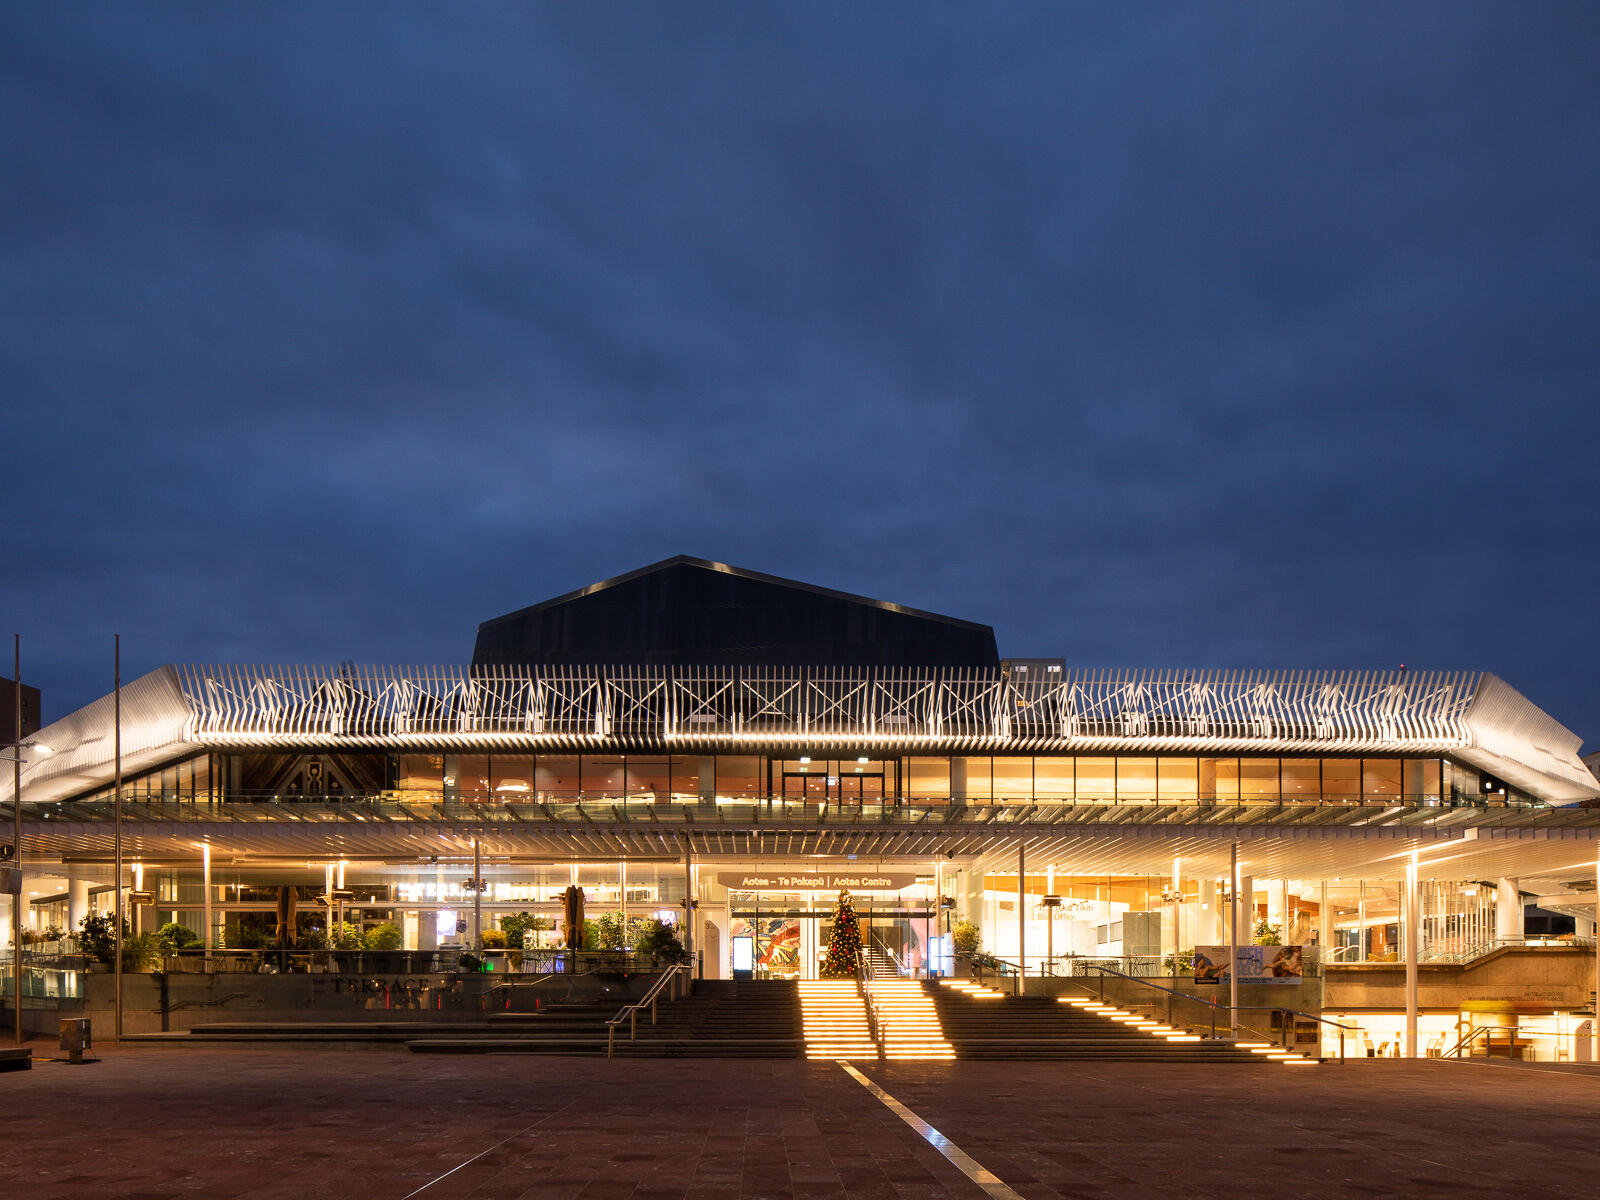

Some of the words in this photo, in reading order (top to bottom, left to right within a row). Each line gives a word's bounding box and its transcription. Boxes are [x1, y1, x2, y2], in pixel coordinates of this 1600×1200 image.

[742, 877, 770, 887] Aotea
[777, 877, 790, 887] Te
[833, 877, 861, 887] Aotea
[860, 877, 892, 887] Centre
[1054, 913, 1076, 921] Office
